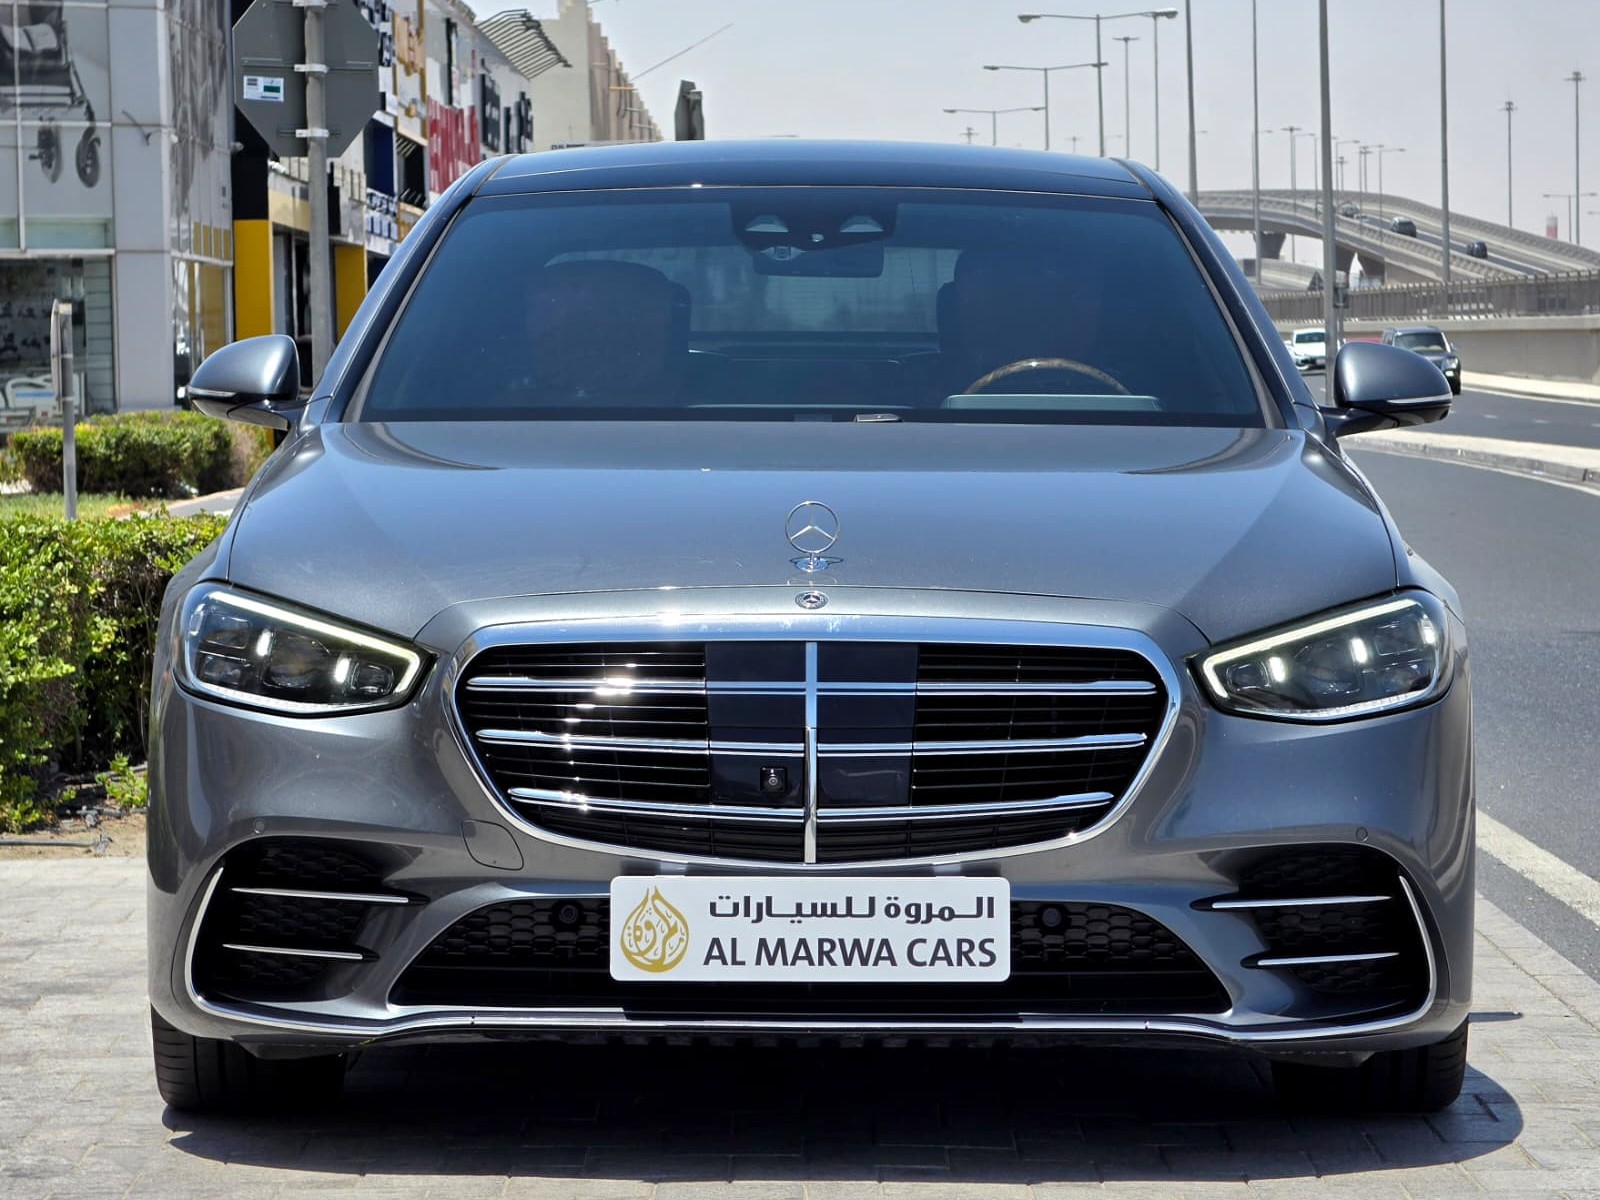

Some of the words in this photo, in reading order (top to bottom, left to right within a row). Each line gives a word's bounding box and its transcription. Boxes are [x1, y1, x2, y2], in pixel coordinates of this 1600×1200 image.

[709, 895, 876, 925] للسيارات
[883, 895, 995, 925] المروة
[703, 937, 746, 967] AL
[754, 937, 898, 967] MARWA
[906, 937, 997, 967] CARS
